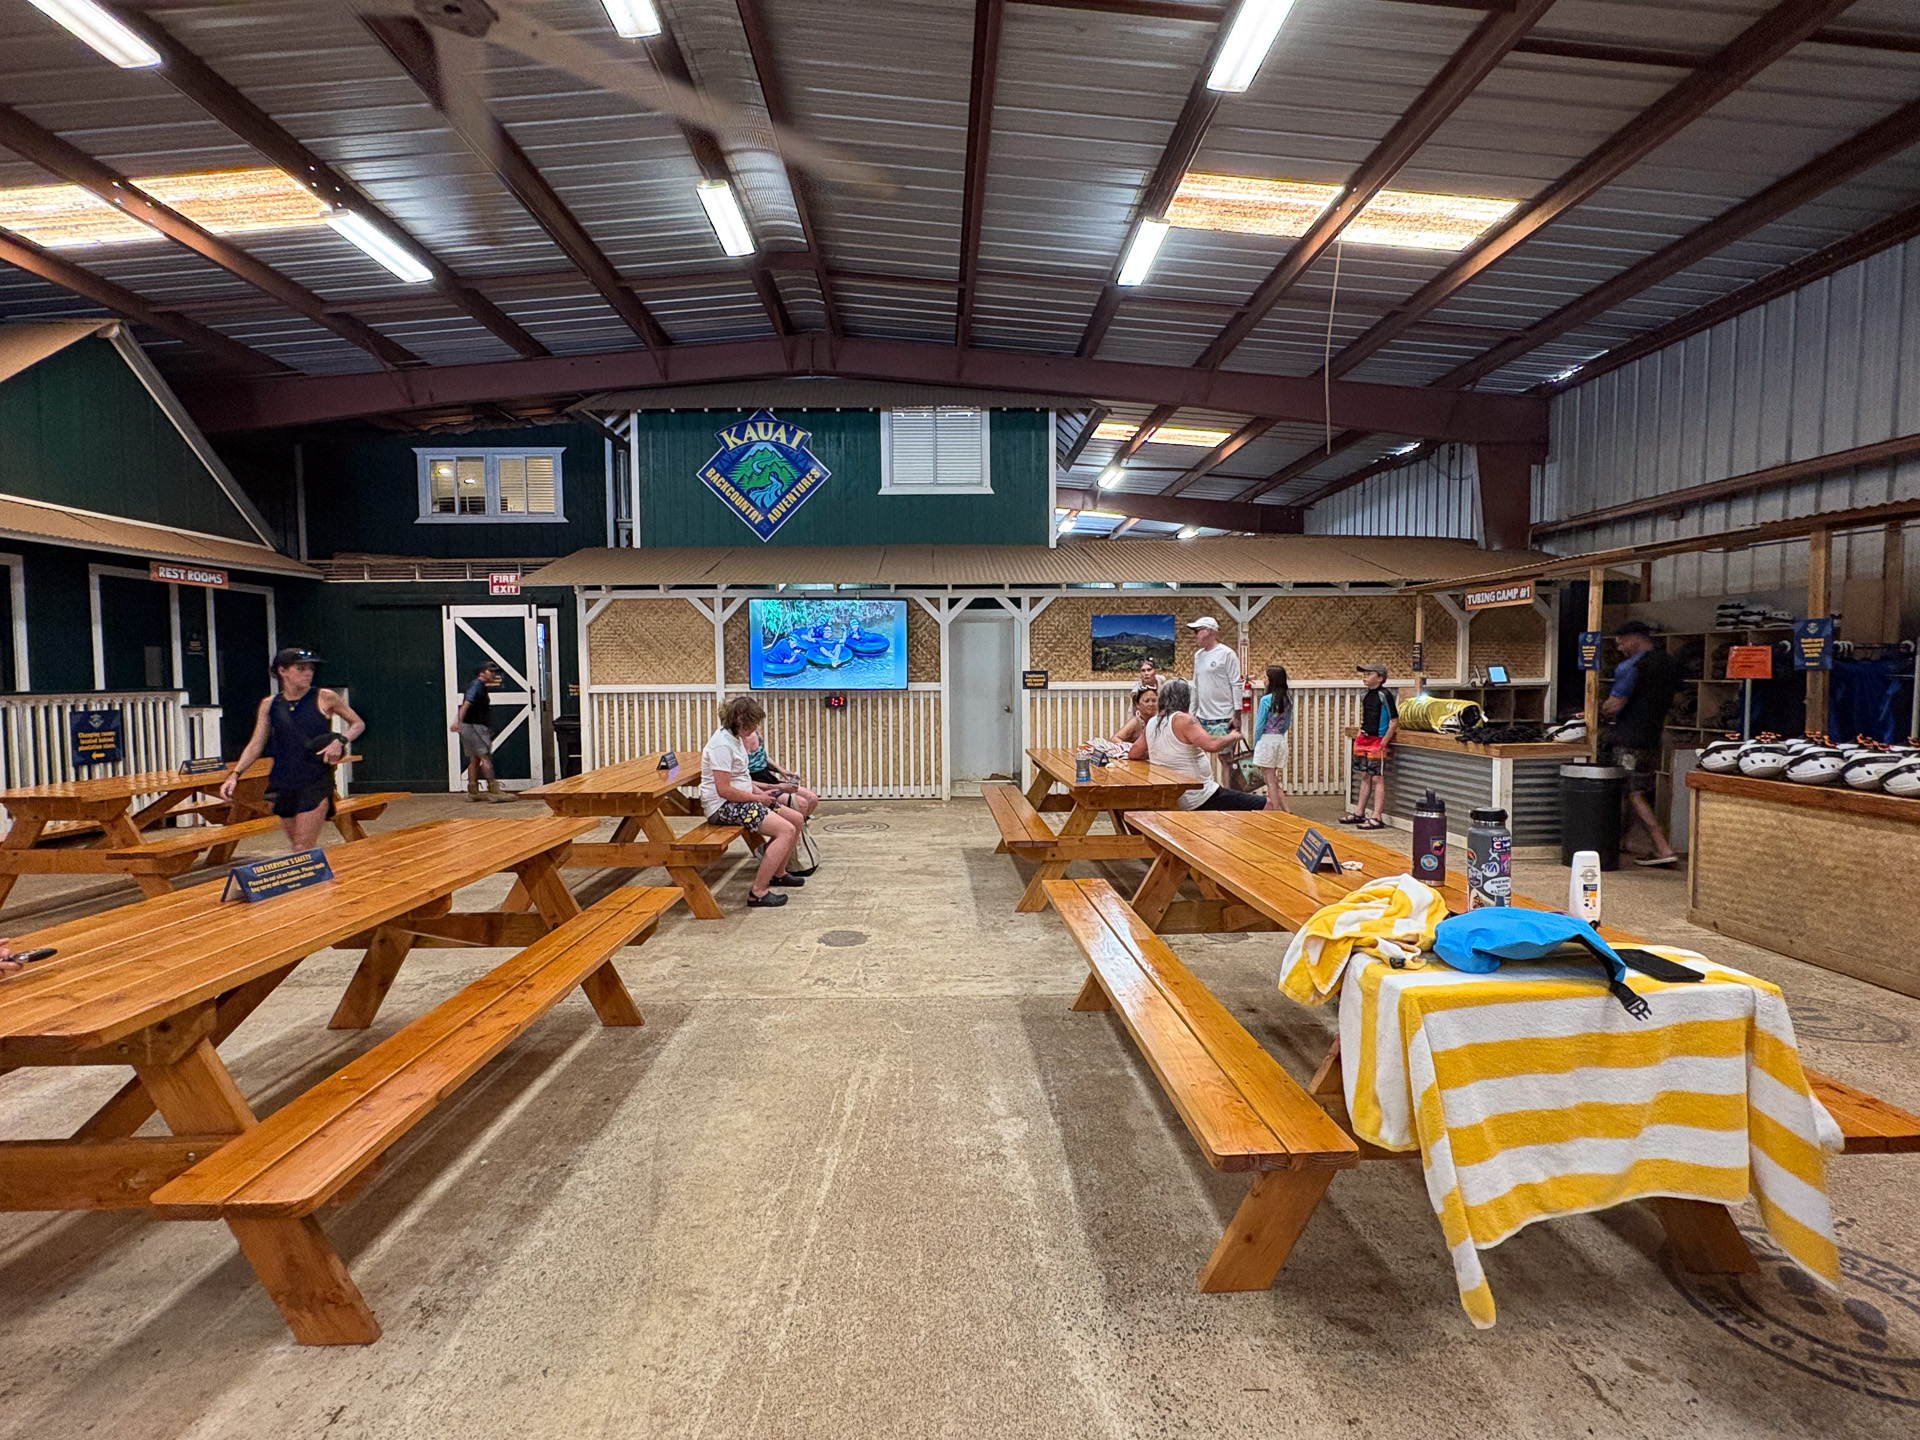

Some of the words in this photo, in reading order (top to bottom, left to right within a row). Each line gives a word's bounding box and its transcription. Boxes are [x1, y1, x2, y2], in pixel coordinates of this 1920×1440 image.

[705, 467, 764, 524] BACKCOUNTRY
[767, 468, 821, 524] ADVENTURES
[158, 566, 186, 580] REST
[187, 570, 223, 584] ROOMS
[493, 575, 516, 583] FIRE
[493, 585, 517, 593] EXIT
[1467, 591, 1496, 605] TUBING
[1496, 588, 1519, 601] CAMP
[1519, 586, 1530, 599] #1
[252, 866, 265, 874] FOR
[264, 858, 295, 872] EVERYONE'S
[294, 854, 311, 864] SAFETY
